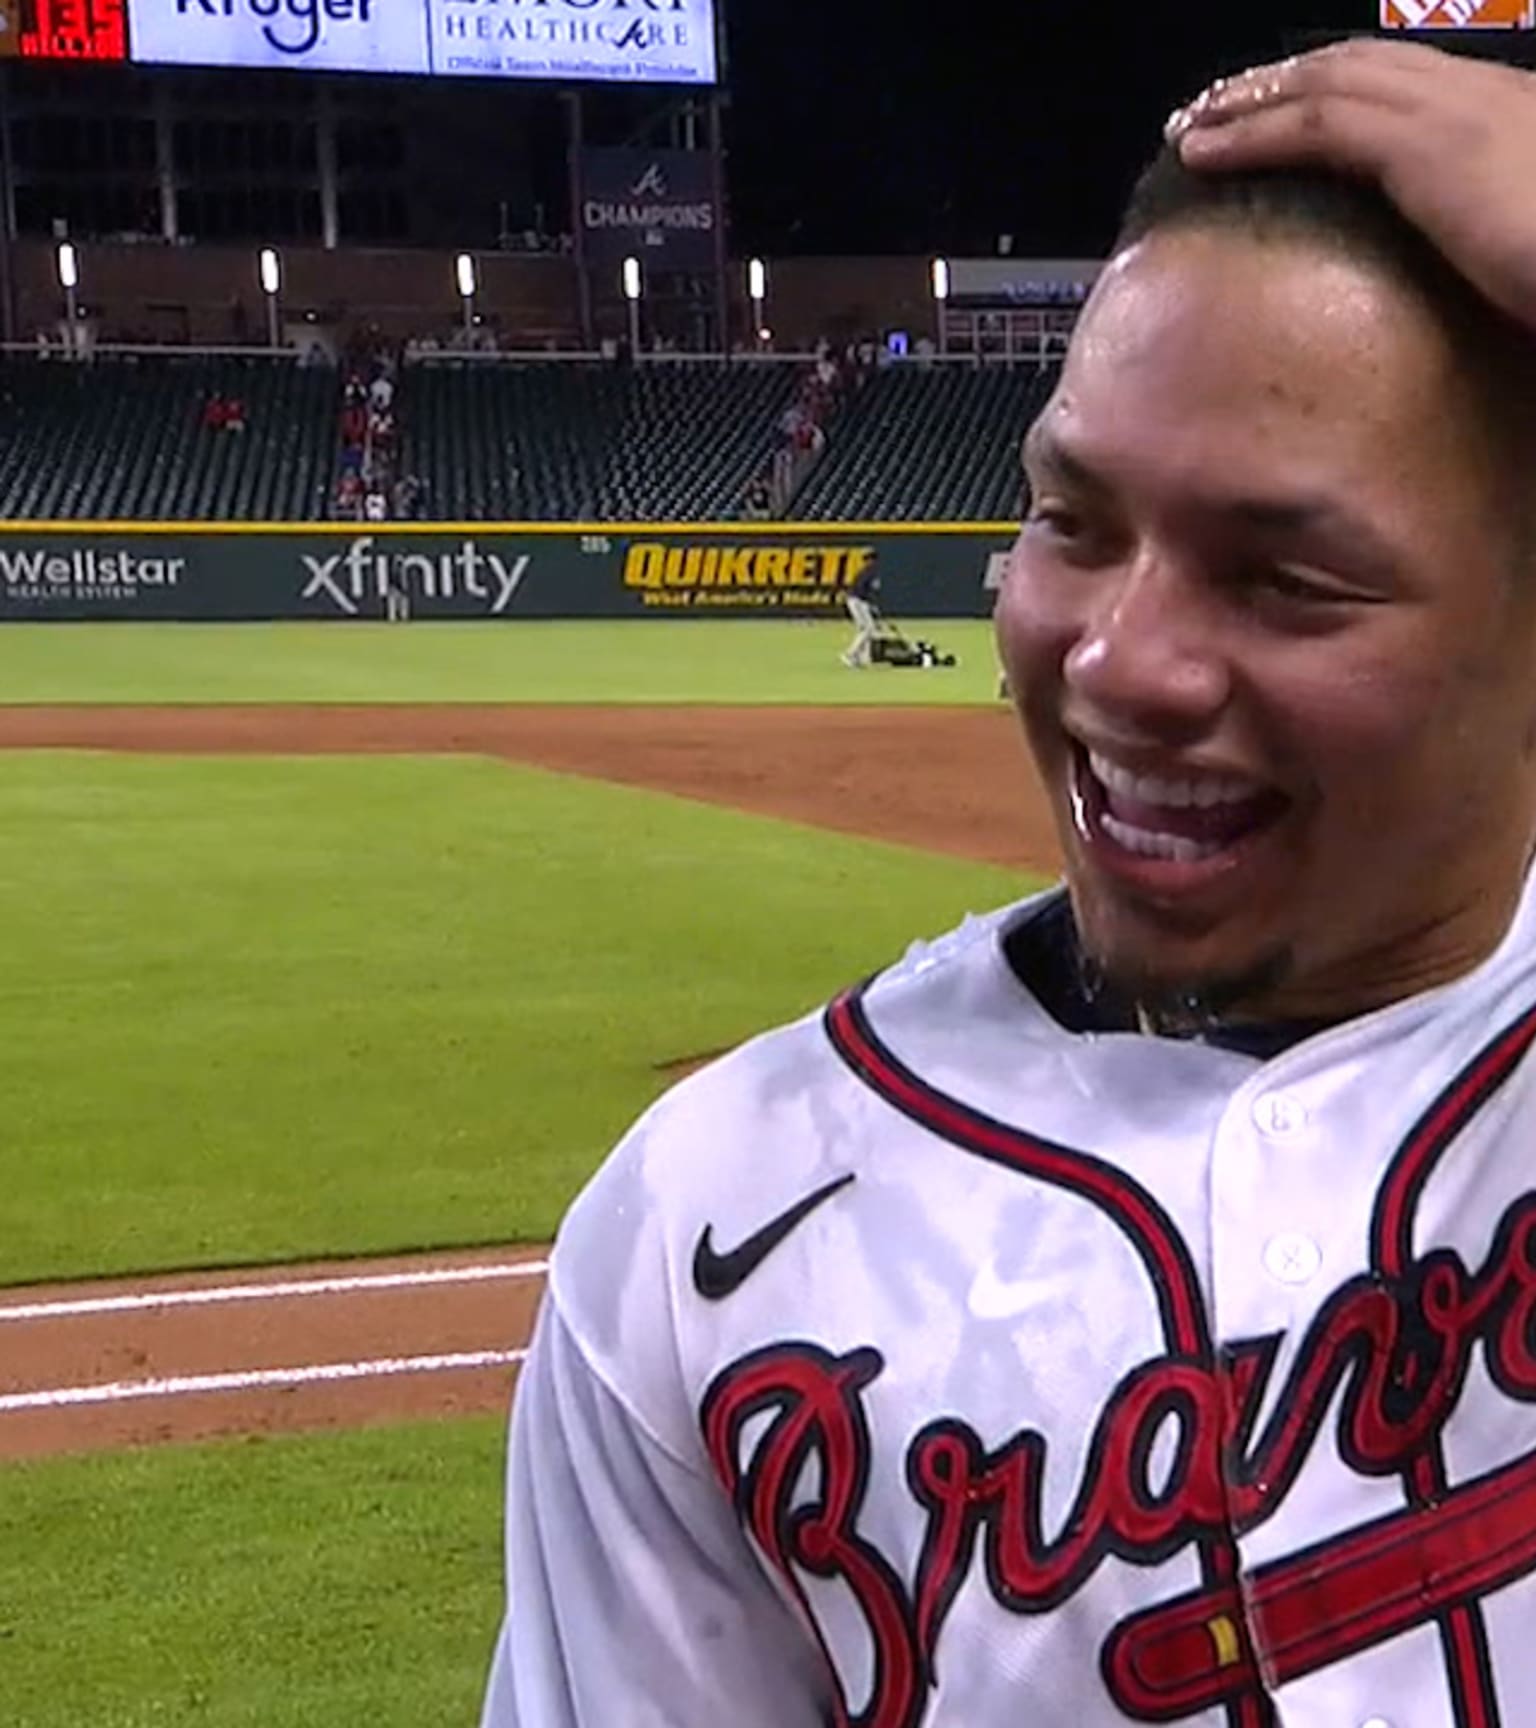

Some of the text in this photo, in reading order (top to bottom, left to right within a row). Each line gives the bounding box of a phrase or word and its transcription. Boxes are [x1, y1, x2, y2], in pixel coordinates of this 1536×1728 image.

[446, 15, 689, 49] HEALTHCARE
[584, 202, 712, 229] CHAMPIONS
[0, 550, 185, 585] Wellstar
[300, 537, 530, 613] xfinity
